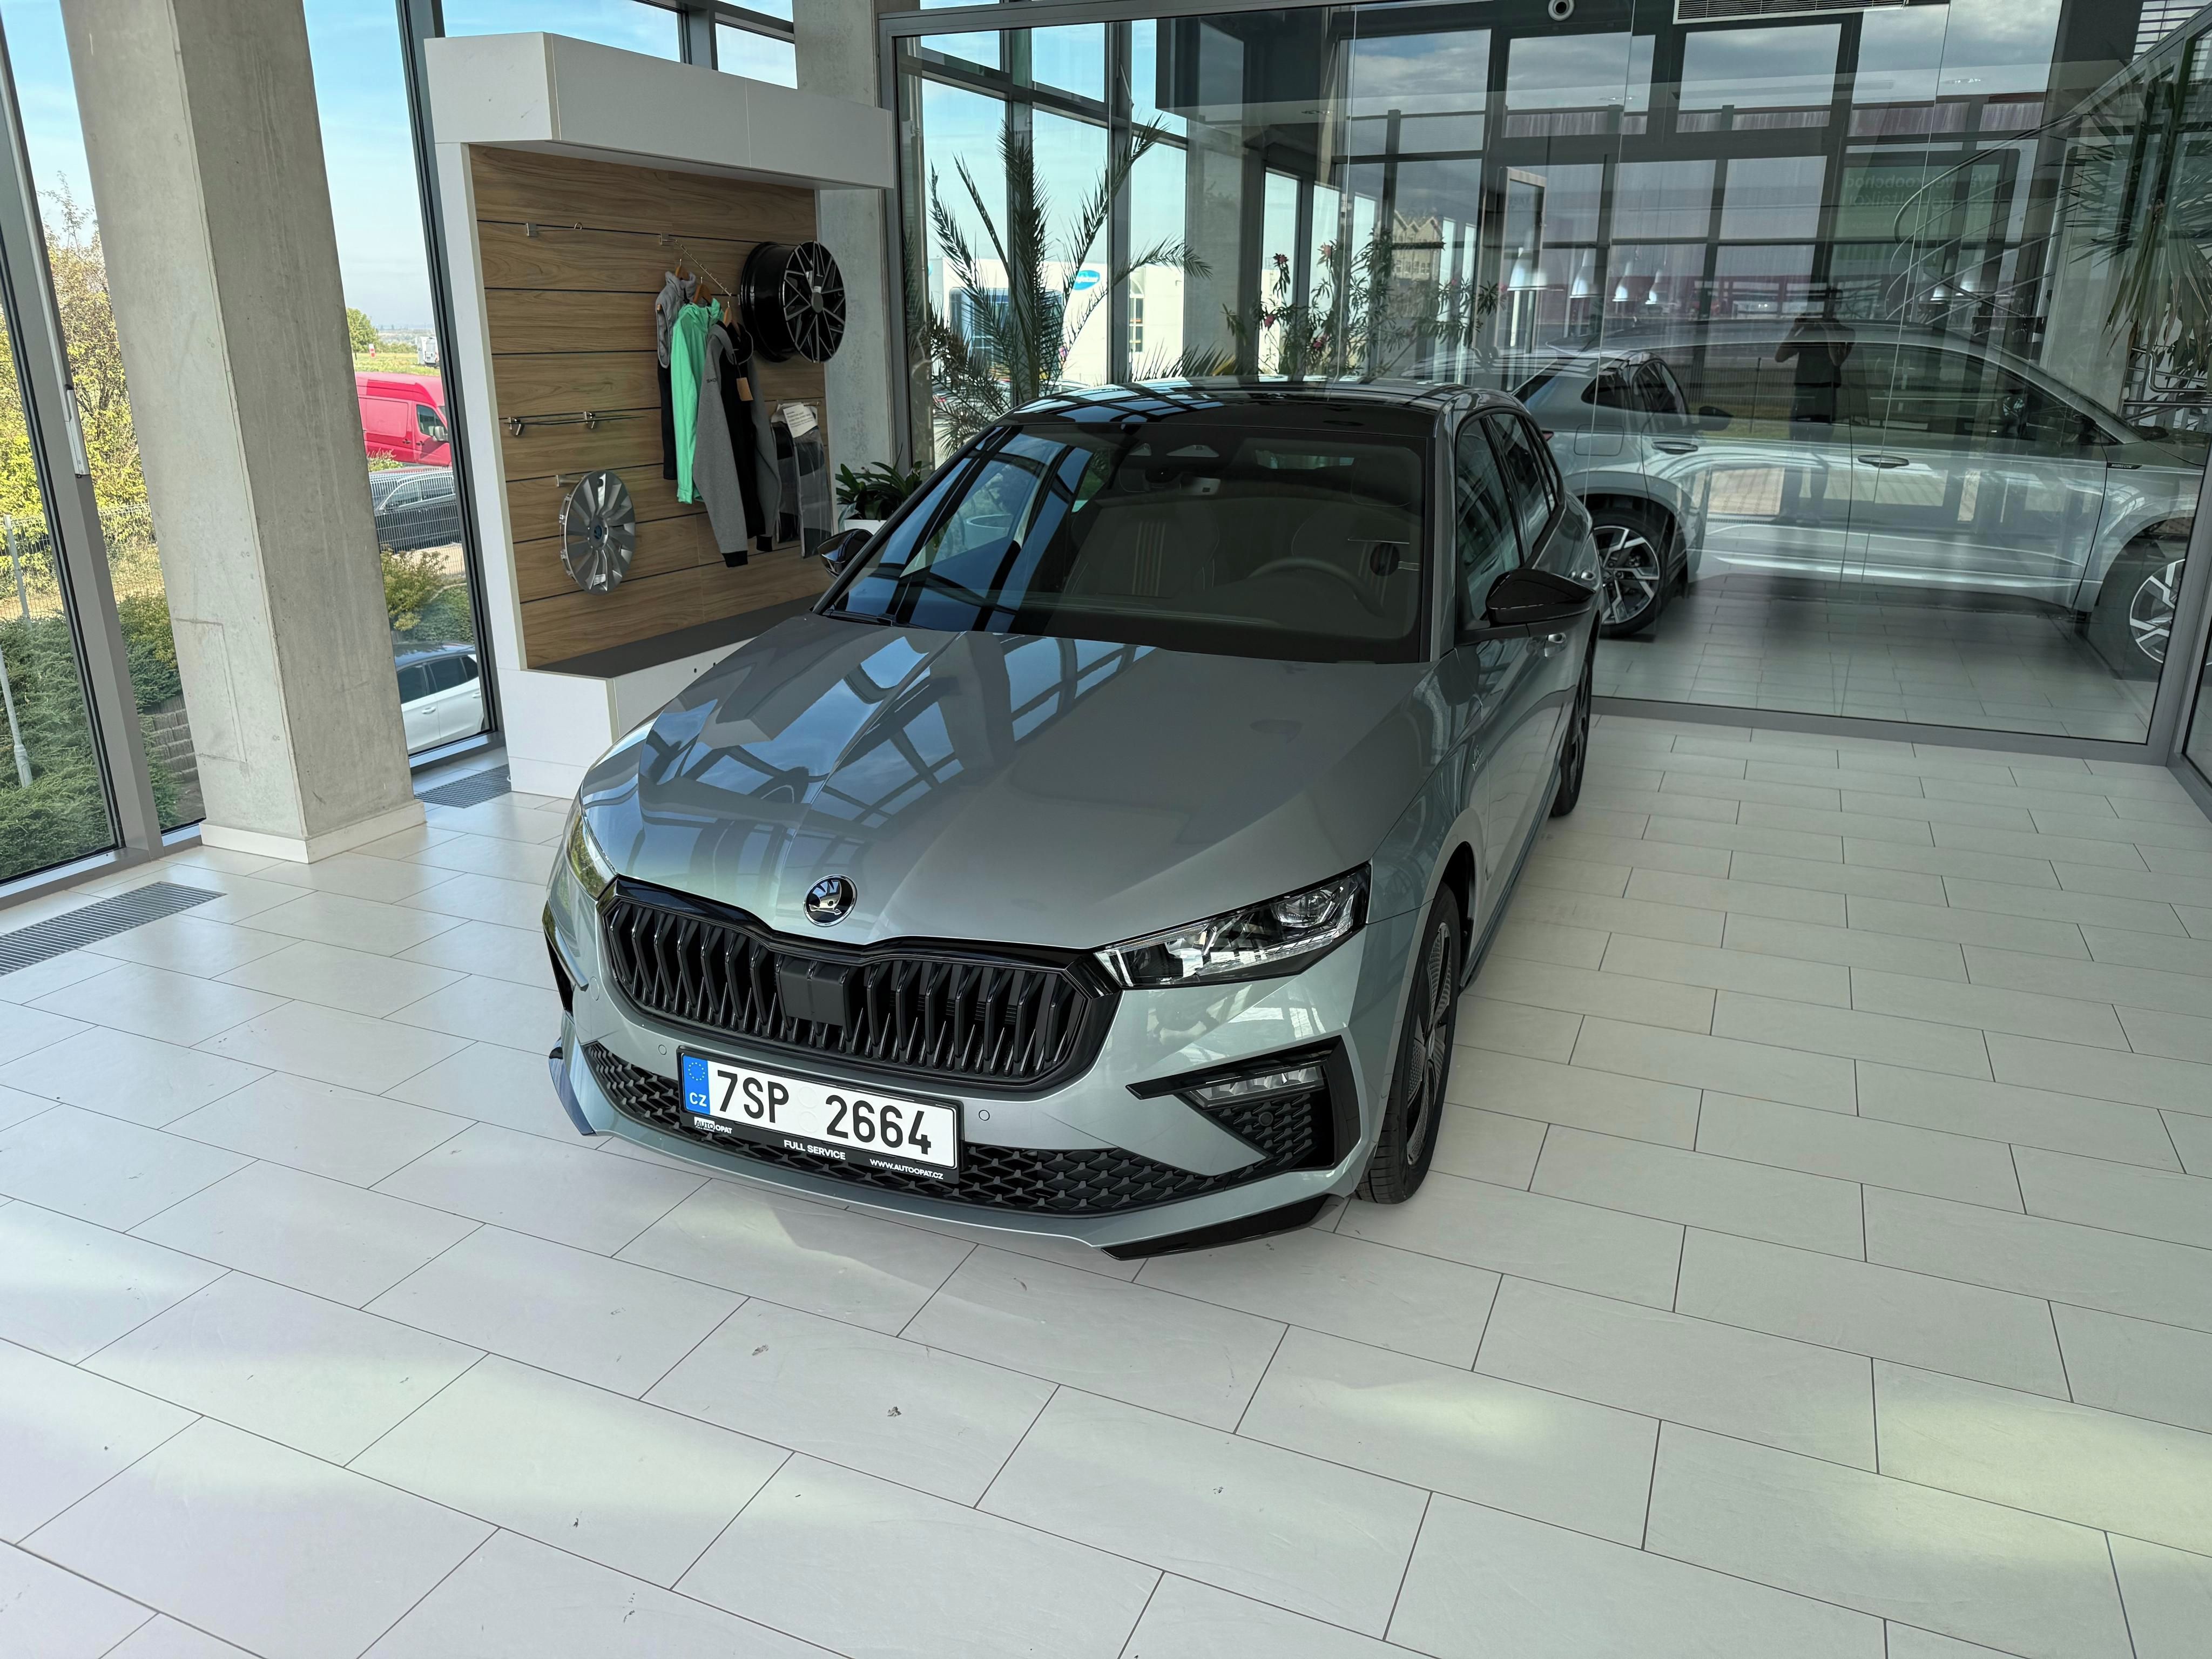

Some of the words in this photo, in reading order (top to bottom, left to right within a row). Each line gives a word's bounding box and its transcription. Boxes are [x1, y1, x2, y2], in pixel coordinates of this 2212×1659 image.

[689, 1092, 707, 1107] CZ
[717, 1070, 789, 1123] 7SP
[825, 1095, 932, 1155] 2664
[784, 1139, 806, 1153] FULL
[807, 1144, 846, 1161] SERVICE
[869, 1158, 944, 1180] WWW.AUTOOPAT.CZ
